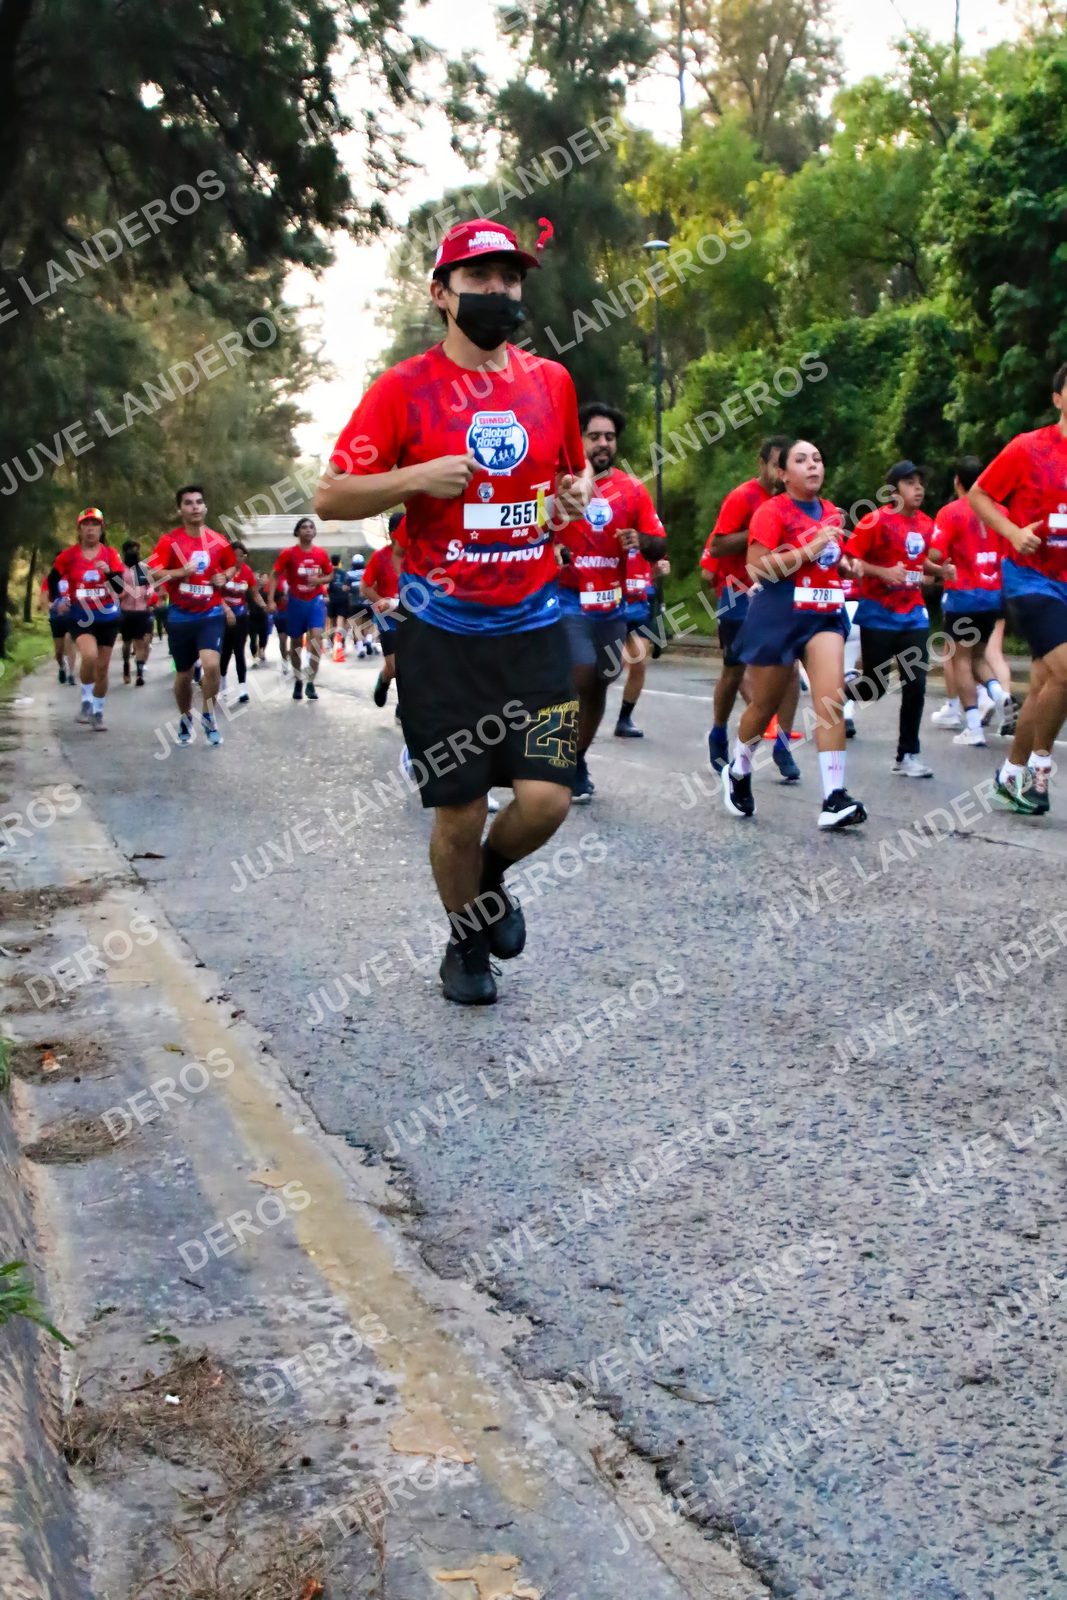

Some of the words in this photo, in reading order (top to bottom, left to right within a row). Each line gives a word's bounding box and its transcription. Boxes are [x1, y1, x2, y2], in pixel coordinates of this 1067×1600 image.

[479, 417, 510, 425] BIMBO
[482, 427, 512, 438] Global
[477, 437, 502, 448] Race
[500, 501, 538, 526] 2551
